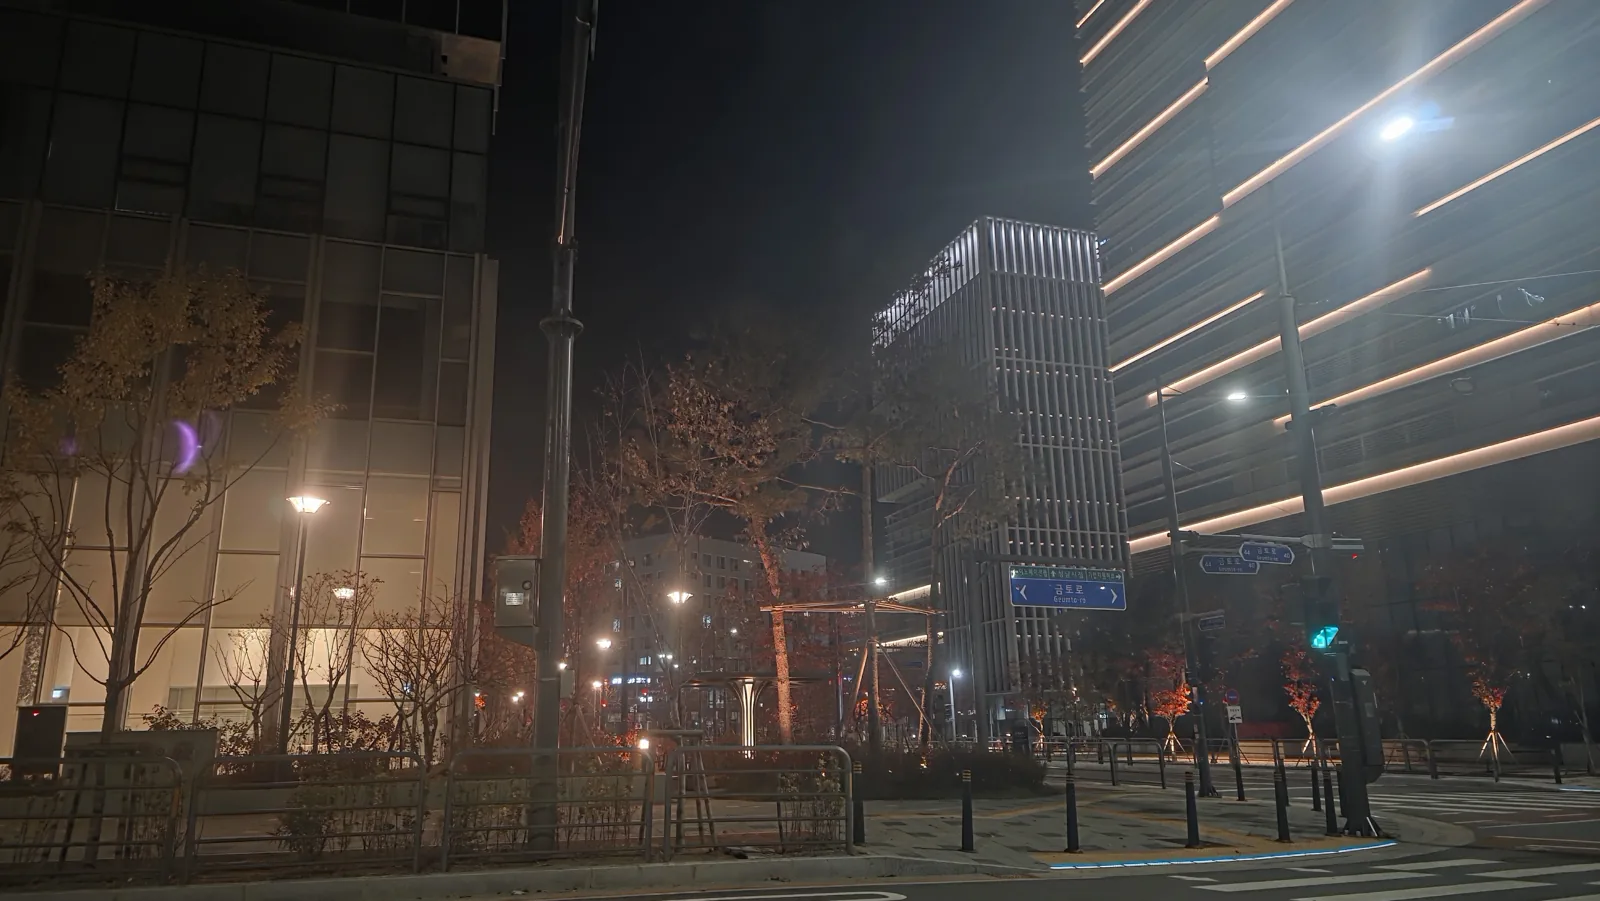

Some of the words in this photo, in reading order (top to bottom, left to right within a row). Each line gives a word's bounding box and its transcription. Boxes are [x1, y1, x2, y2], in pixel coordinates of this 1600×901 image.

[1257, 546, 1277, 555] 금토로
[1054, 584, 1084, 595] 금토로
[1053, 595, 1086, 604] Geumto-ro
